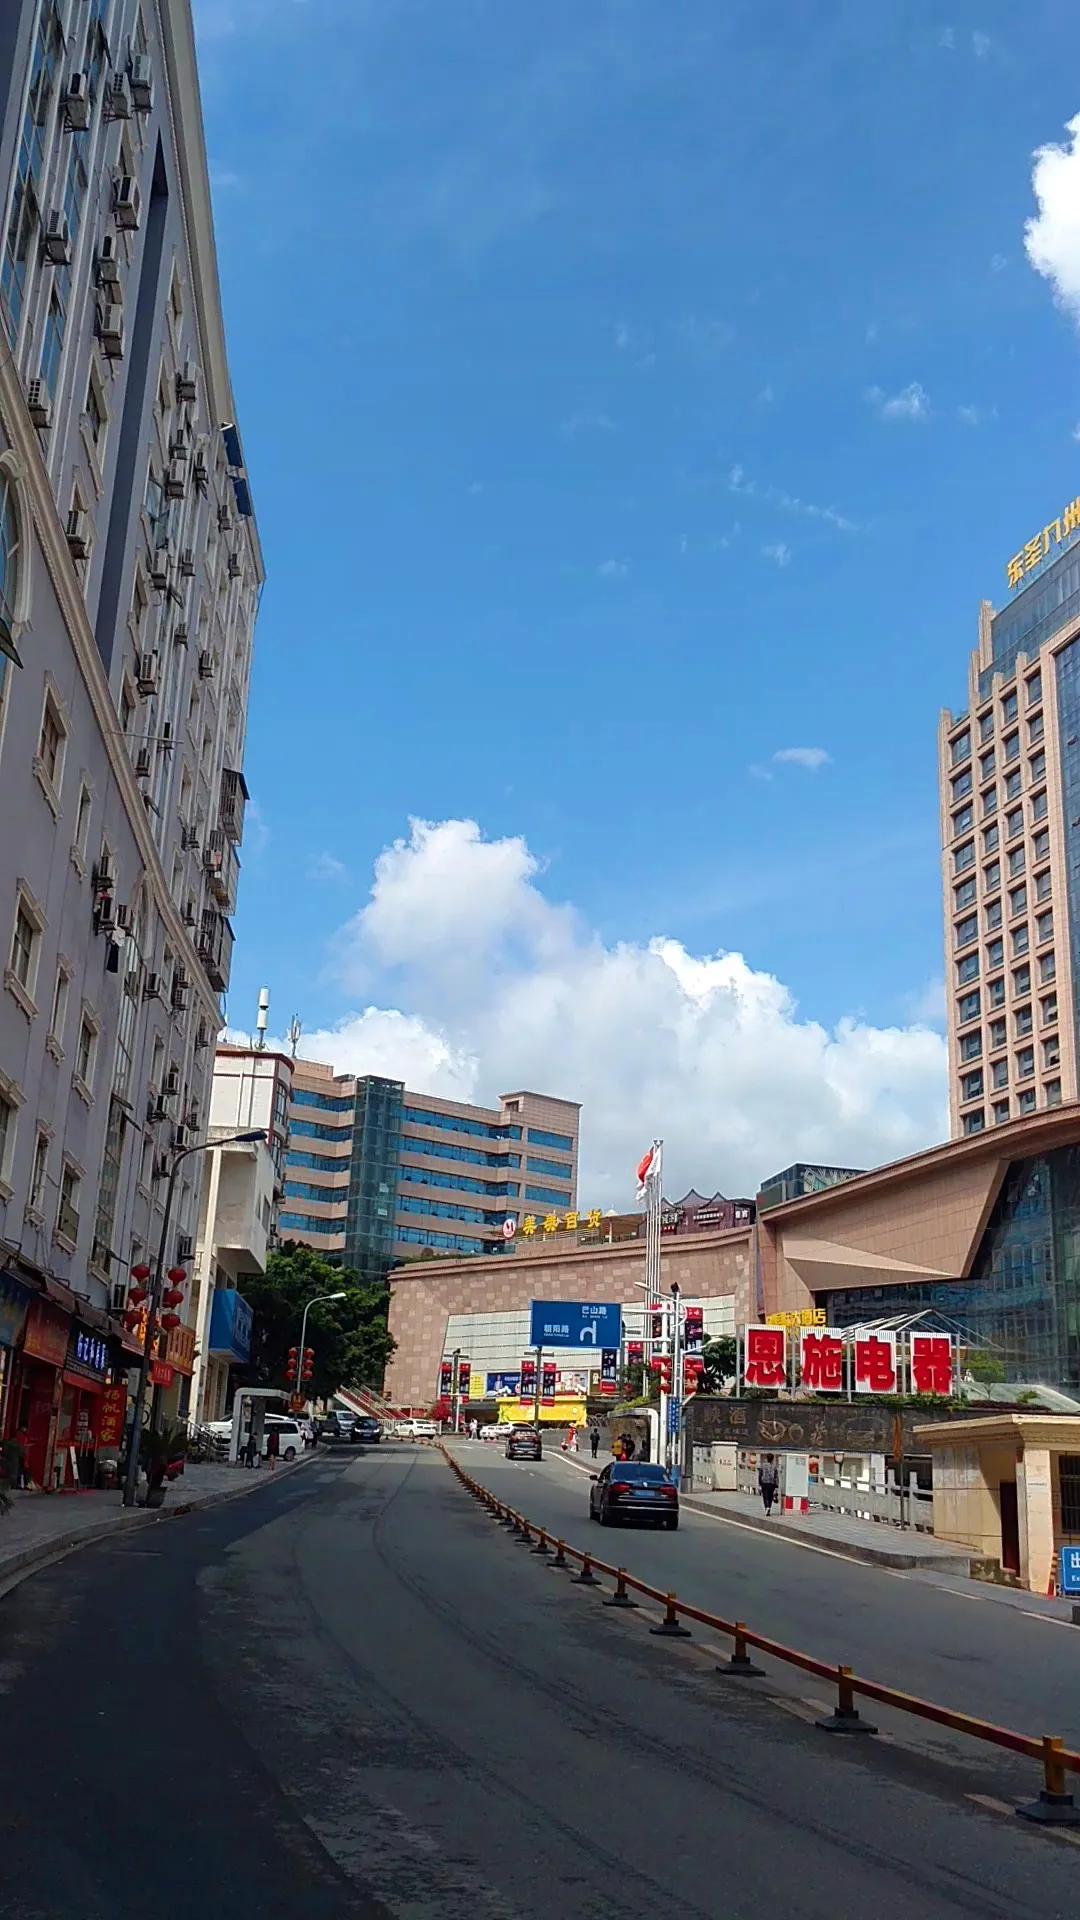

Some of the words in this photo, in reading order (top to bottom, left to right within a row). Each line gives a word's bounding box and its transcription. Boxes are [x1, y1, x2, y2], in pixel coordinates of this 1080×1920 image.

[581, 1305, 607, 1315] 巴山路
[745, 1329, 953, 1393] 恩施电器
